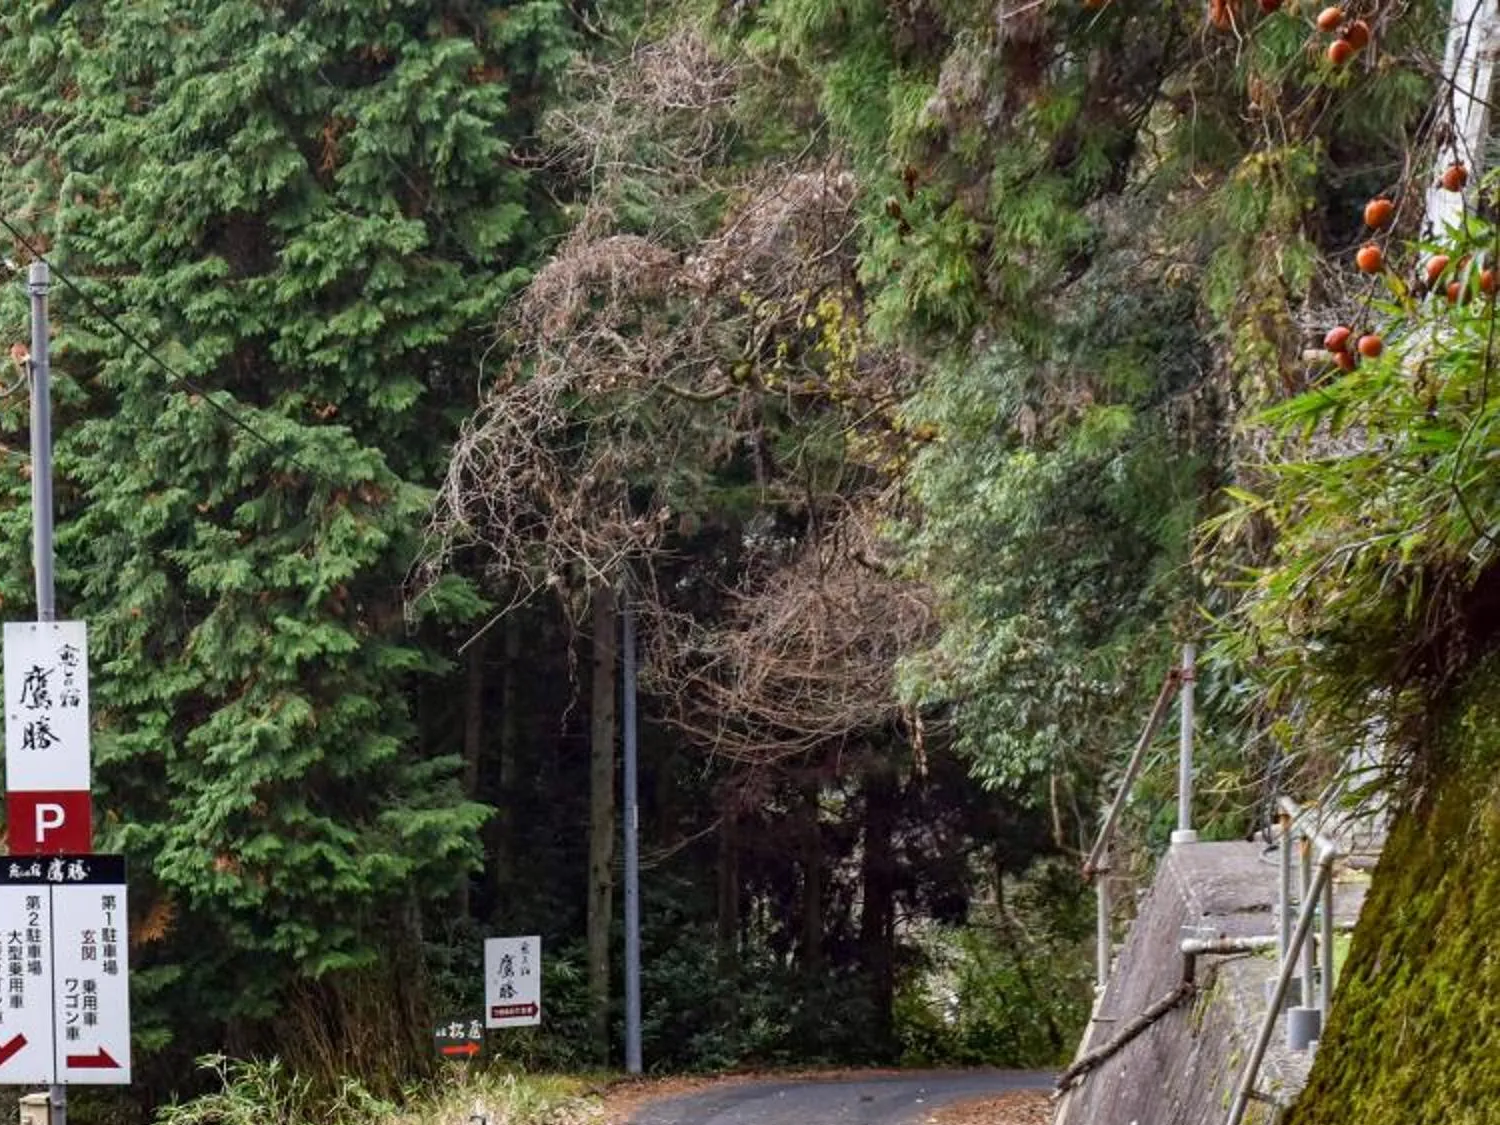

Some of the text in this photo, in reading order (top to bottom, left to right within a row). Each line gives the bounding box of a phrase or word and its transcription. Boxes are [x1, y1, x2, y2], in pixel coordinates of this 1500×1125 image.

[34, 803, 66, 843] P
[7, 929, 24, 1009] 大型乗用車
[25, 894, 43, 976] 第2駐車場
[101, 894, 118, 976] 第1駐車場
[65, 978, 81, 1041] ワゴン車
[80, 929, 98, 1027] 玄関 乗用車
